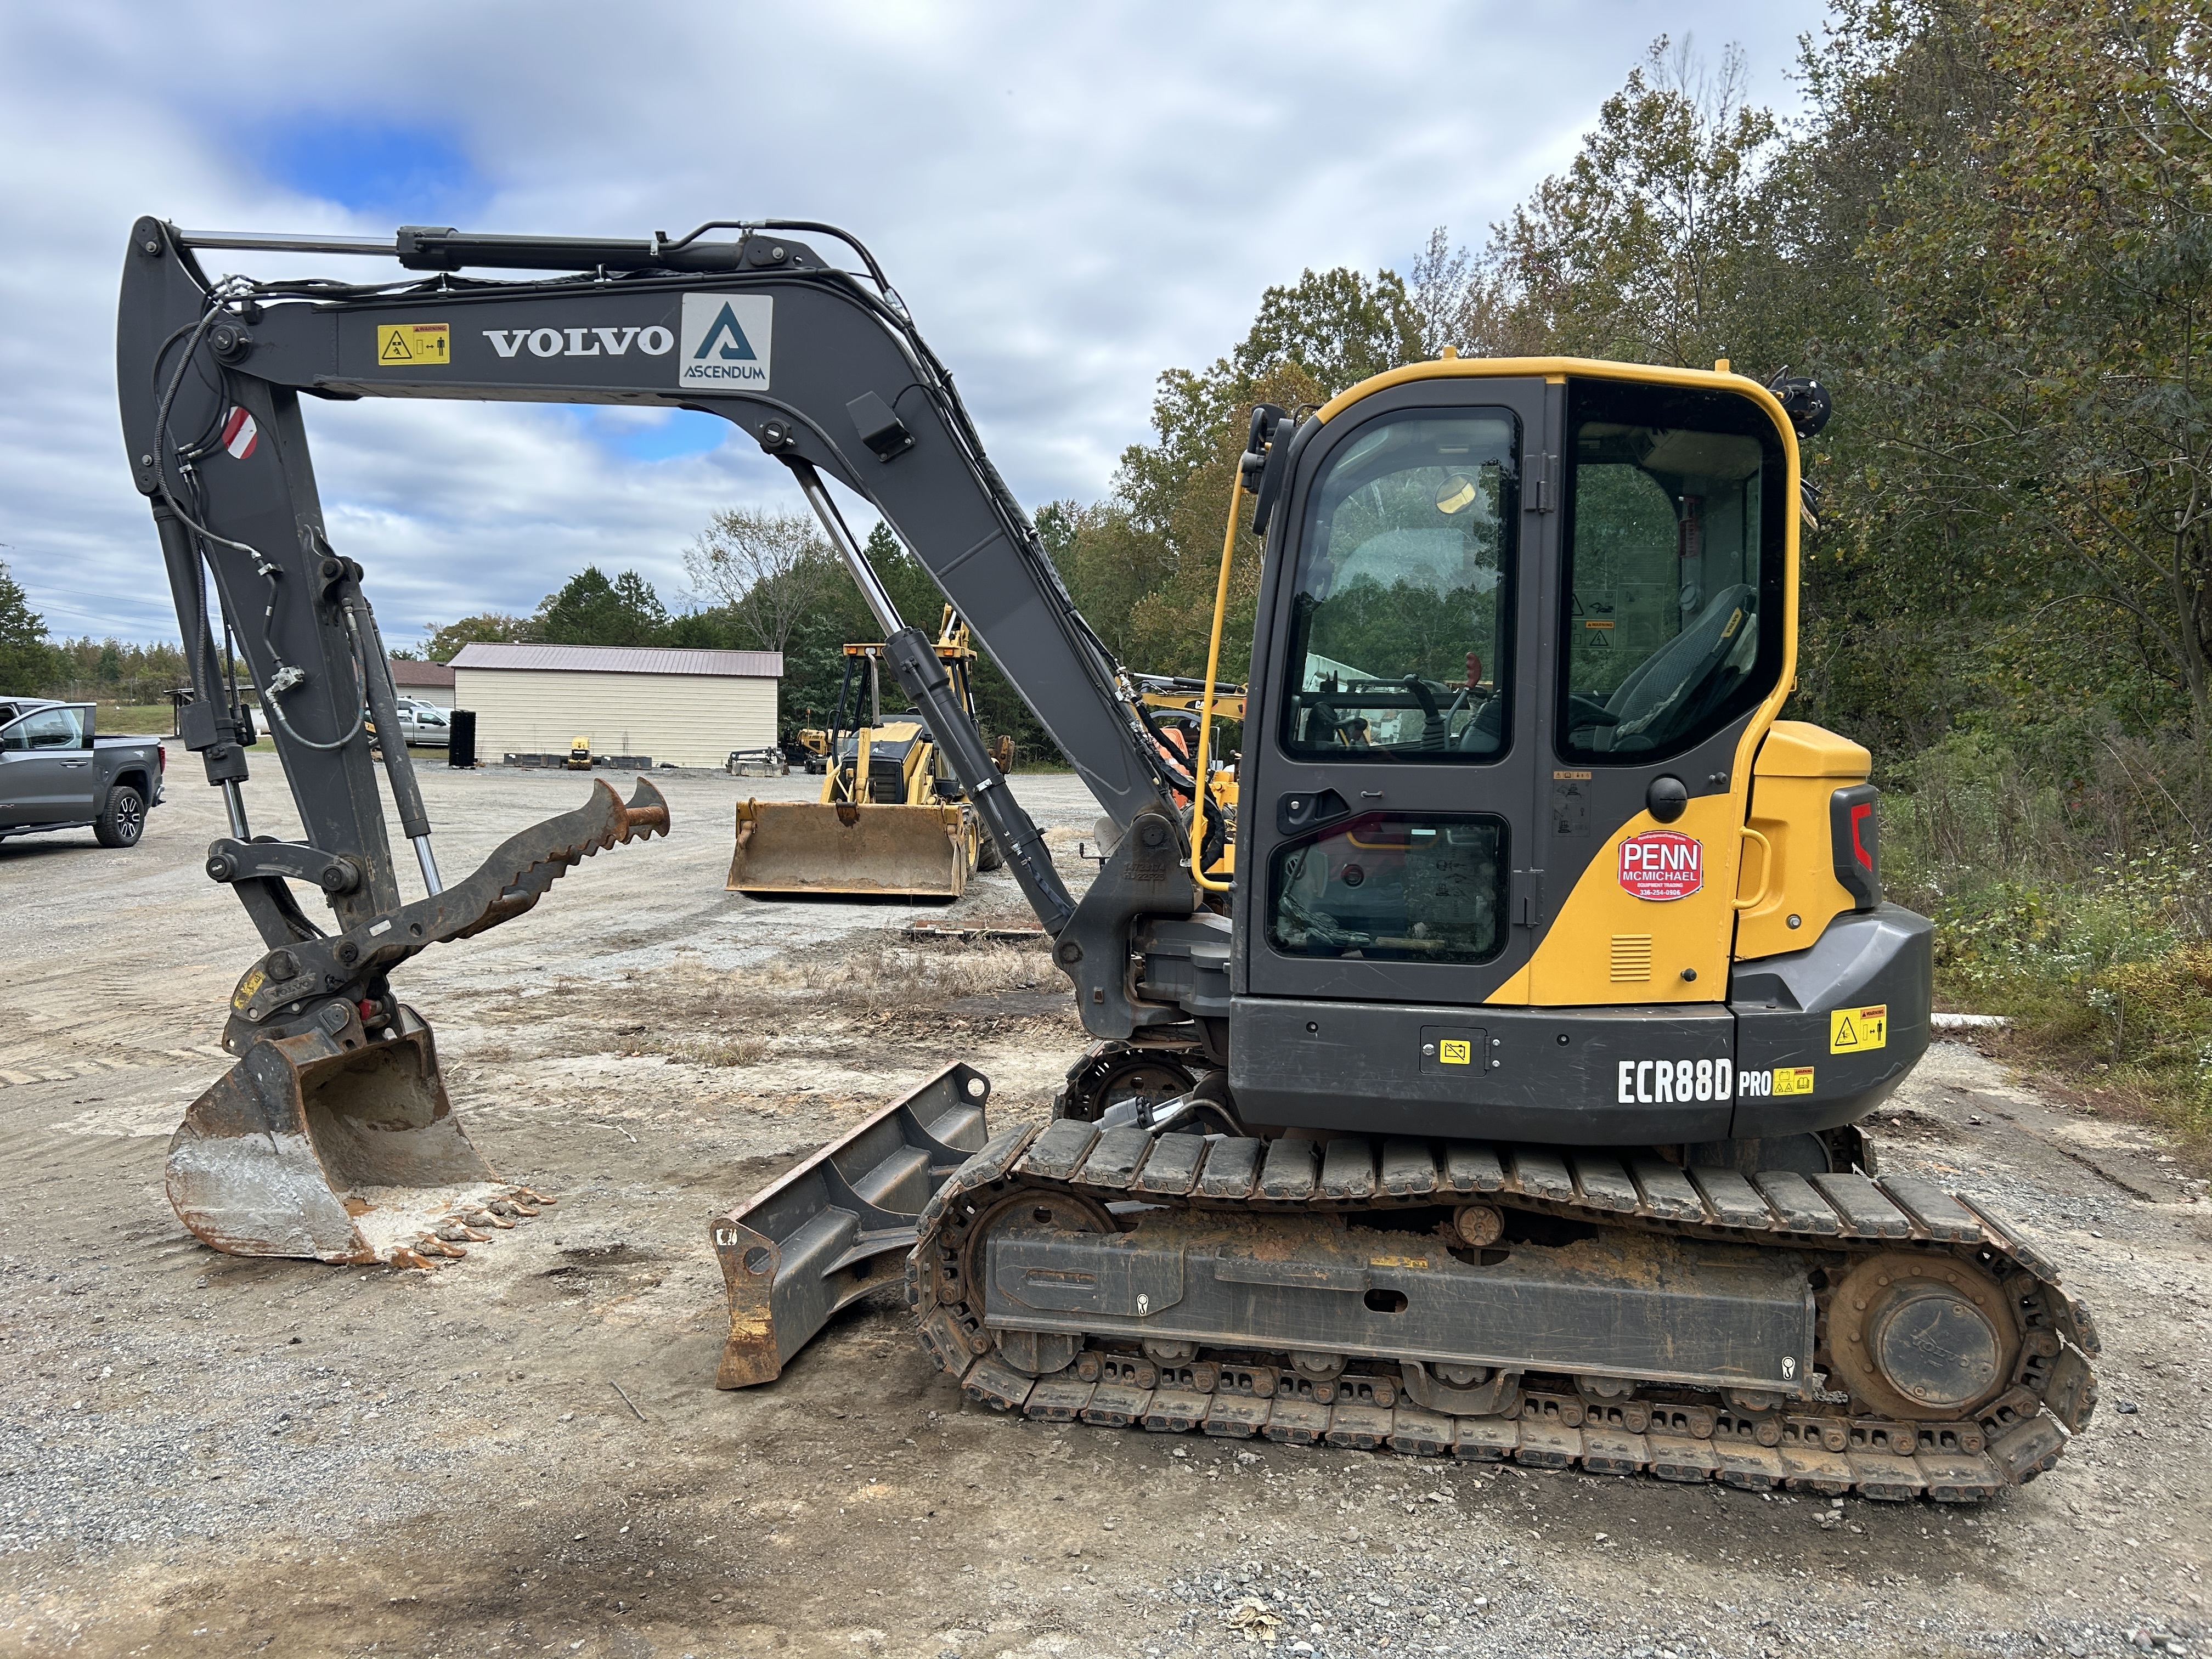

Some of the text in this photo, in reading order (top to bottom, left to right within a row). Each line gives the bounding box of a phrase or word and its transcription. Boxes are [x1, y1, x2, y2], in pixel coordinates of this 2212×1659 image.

[483, 325, 674, 357] VOLVO
[683, 365, 766, 380] ASCENDUM
[1726, 614, 1739, 633] VOLVO
[1624, 843, 1697, 870] PENN
[1623, 871, 1697, 881] MCMICHAEL
[270, 981, 309, 997] VOLVO
[1618, 1058, 1771, 1103] ECR88D PRO
